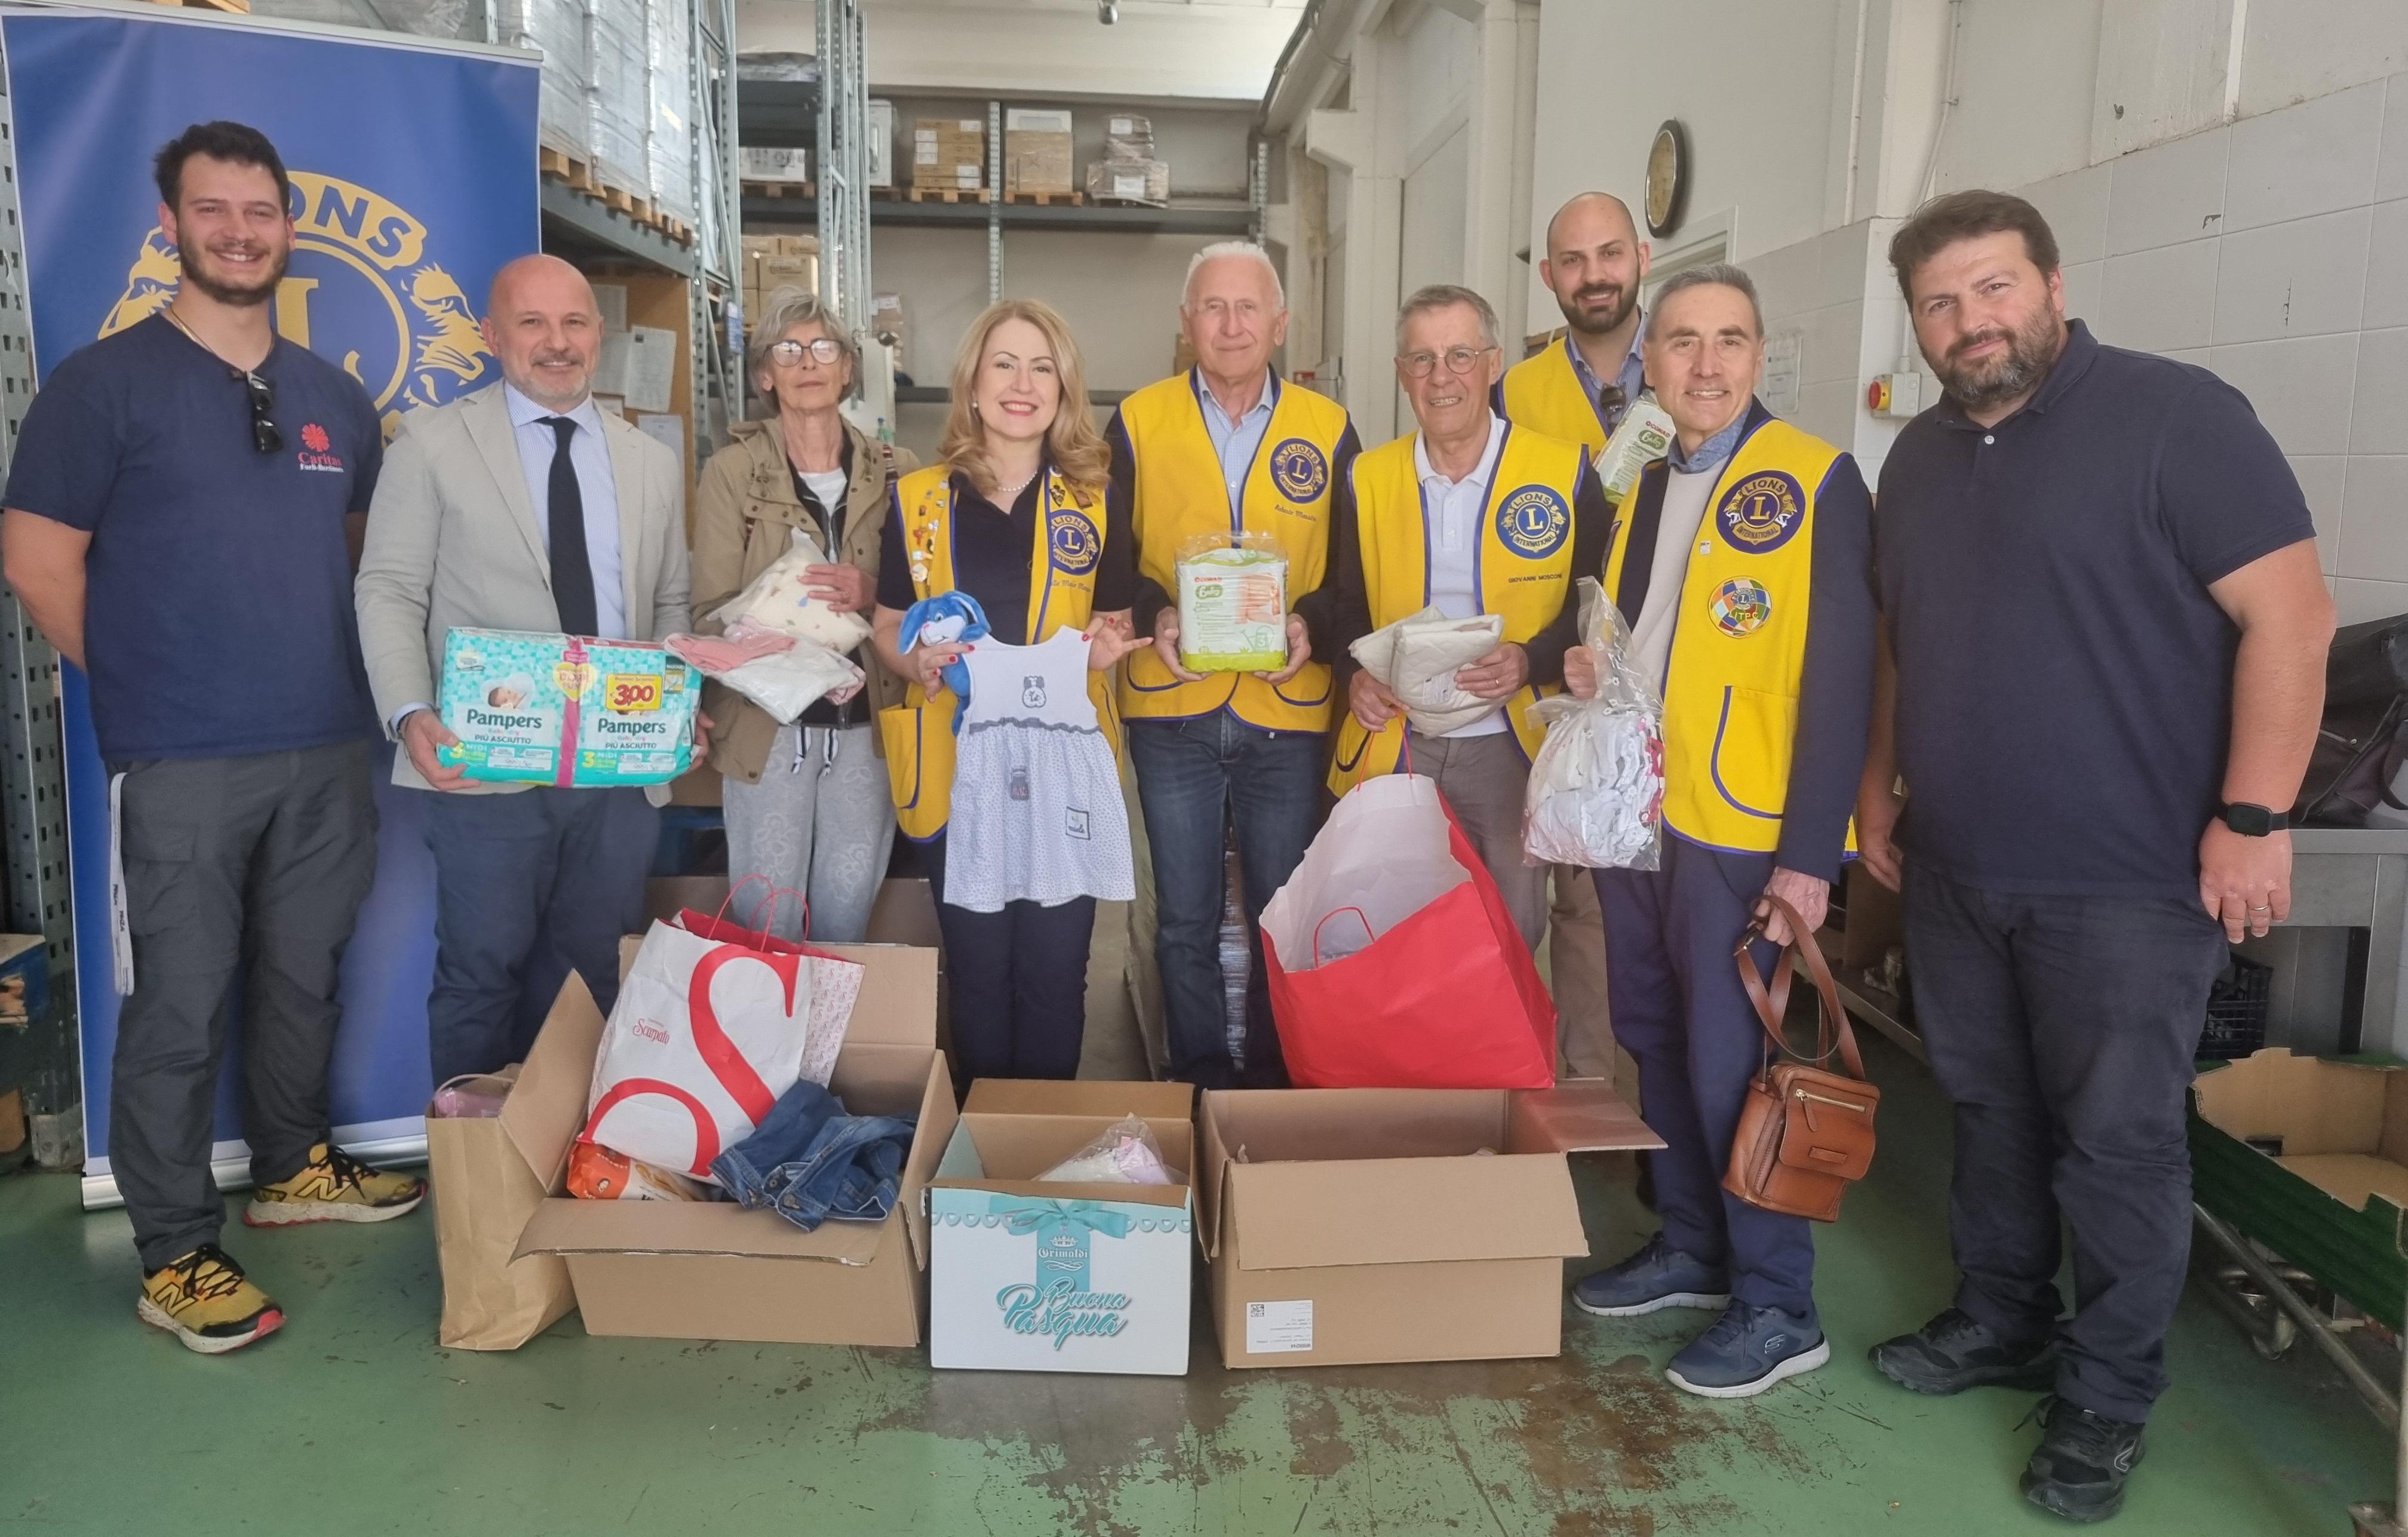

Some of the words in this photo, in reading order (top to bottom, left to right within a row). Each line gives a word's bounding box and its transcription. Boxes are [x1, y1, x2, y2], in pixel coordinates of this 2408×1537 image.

[298, 451, 342, 466] Caritas
[1289, 444, 1319, 463] LIONS
[1291, 457, 1307, 479] L
[1744, 479, 1785, 493] LIONS
[1513, 493, 1552, 507] LIONS
[1749, 496, 1771, 519] L
[1054, 516, 1088, 531] LIONS
[1525, 508, 1544, 530] L
[1064, 528, 1081, 550] L
[1736, 525, 1779, 538] INTERNATIONAL
[1515, 534, 1556, 548] INTERNATIONAL
[466, 708, 543, 730] Pampers
[598, 718, 666, 736] Pampers
[474, 733, 489, 742] PIÙ
[491, 735, 532, 745] ASCIUTTO
[582, 751, 596, 768] 3
[632, 1018, 669, 1044] Scarpato
[1038, 1247, 1088, 1258] Grimaldi
[1043, 1276, 1132, 1312] Buona
[996, 1283, 1128, 1350] Pasqua
